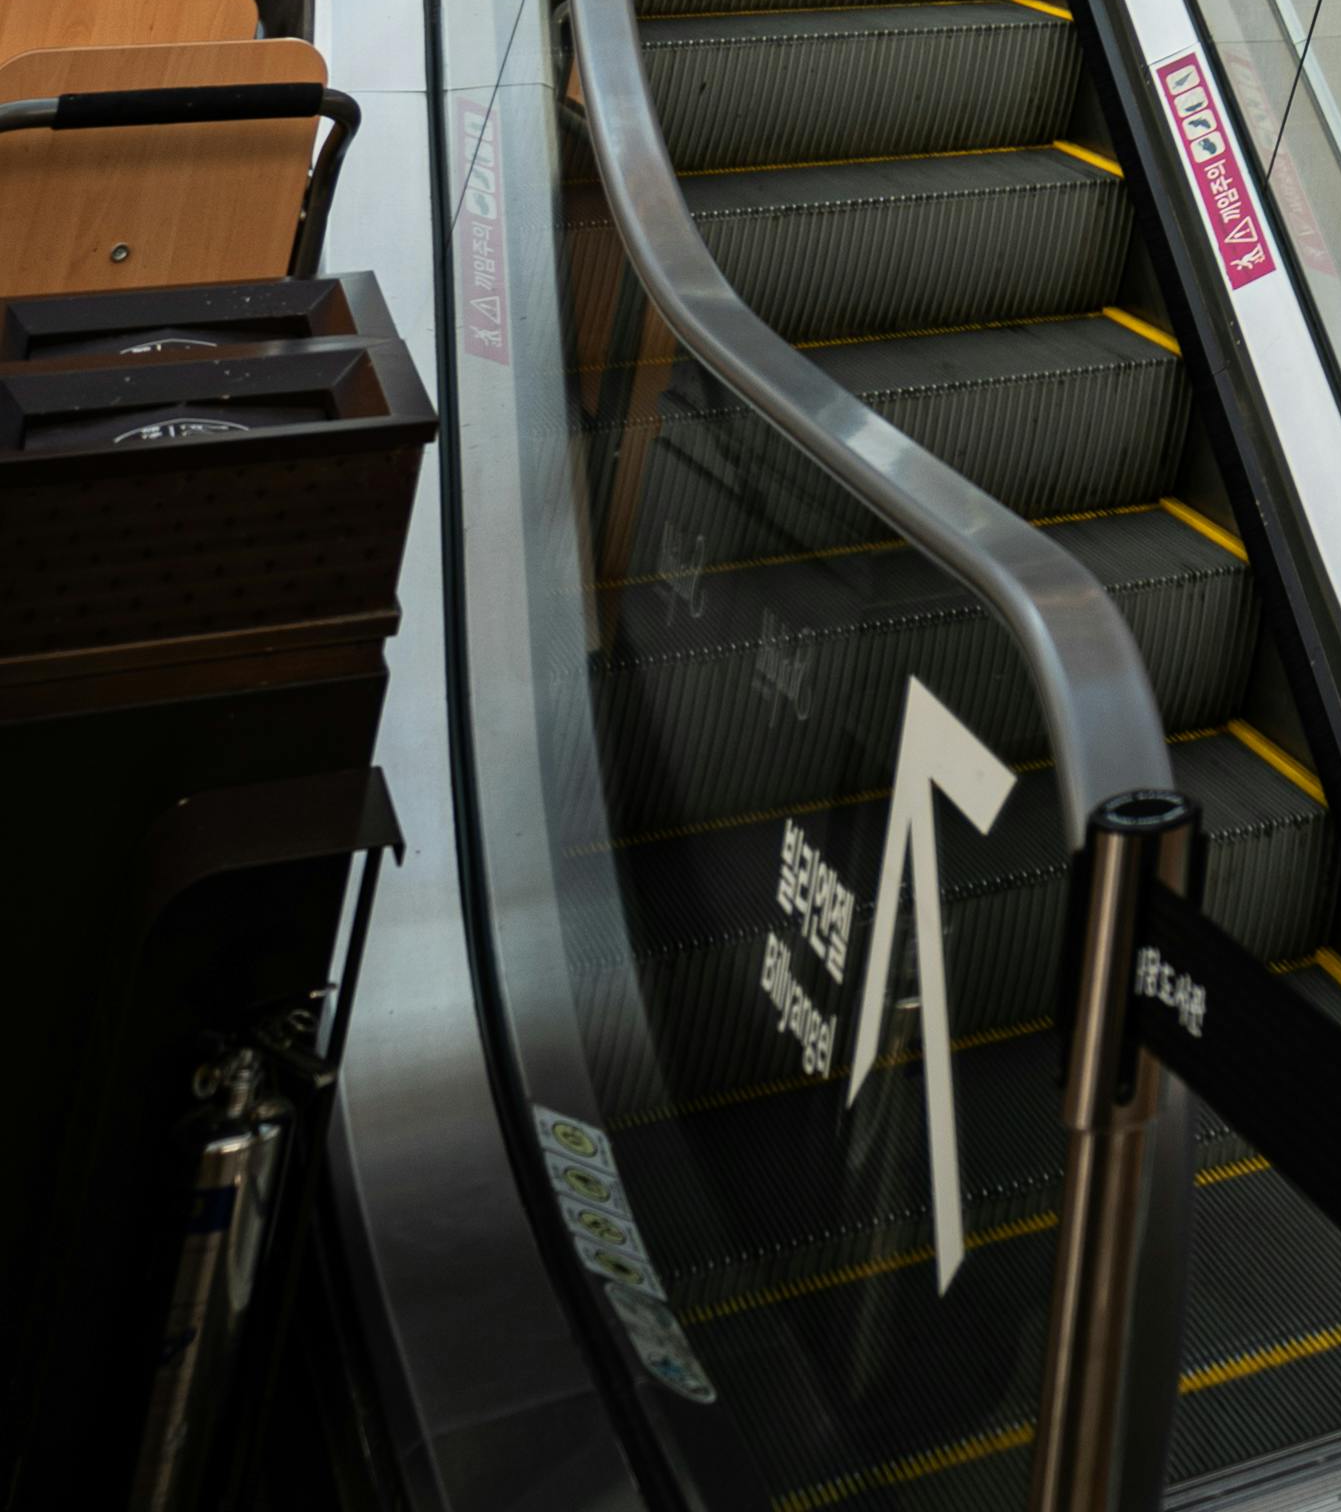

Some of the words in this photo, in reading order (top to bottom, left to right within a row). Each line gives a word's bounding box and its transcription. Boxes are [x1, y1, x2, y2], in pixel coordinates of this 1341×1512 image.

[1210, 158, 1243, 226] 끼임주의
[776, 817, 855, 986] 빌리엔젤
[760, 932, 838, 1079] Billyangel
